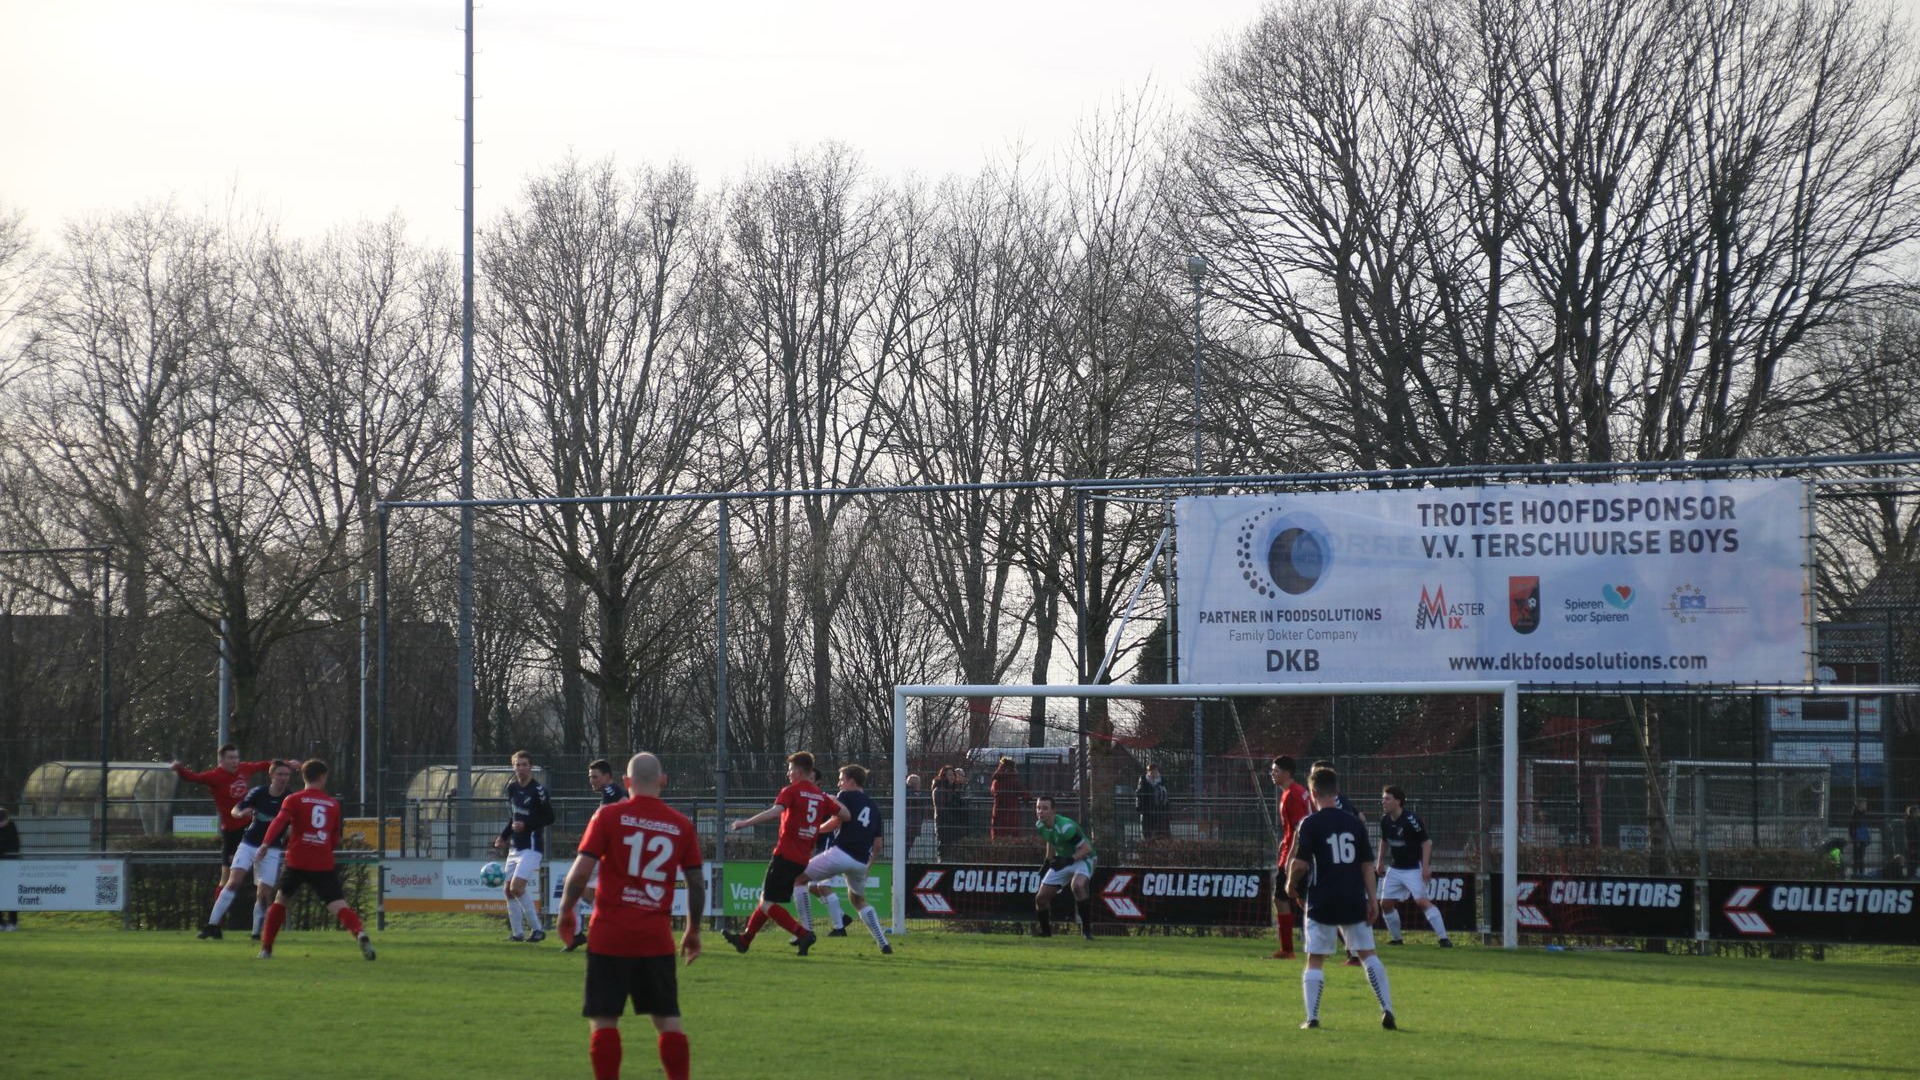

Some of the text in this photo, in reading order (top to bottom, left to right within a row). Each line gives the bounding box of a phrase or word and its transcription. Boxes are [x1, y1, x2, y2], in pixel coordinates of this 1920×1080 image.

[1417, 496, 1737, 527] TROTSE HOOFDSPONSOR
[1421, 528, 1739, 559] V.V. TERSCHUURSE BOYS
[1200, 608, 1382, 624] PARTNER IN FOODSOLUTIONS
[1565, 599, 1604, 610] Spieren
[1565, 612, 1629, 624] voor Spieren
[1229, 628, 1358, 643] Family Dokter Company
[1266, 649, 1320, 672] DKB
[1449, 652, 1708, 671] www.dkbfoodsolutions.com
[311, 805, 326, 829] 6
[806, 799, 818, 824] 5
[857, 806, 870, 828] 4
[623, 831, 673, 882] 12
[1326, 832, 1356, 864] 16
[18, 884, 66, 894] Barneveldse
[390, 873, 432, 887] RegioBank
[953, 870, 1040, 893] COLLECTO
[1142, 873, 1261, 898] COLLECTORS
[1550, 880, 1682, 908] COLLECTORS
[1772, 886, 1914, 915] COLLECTORS
